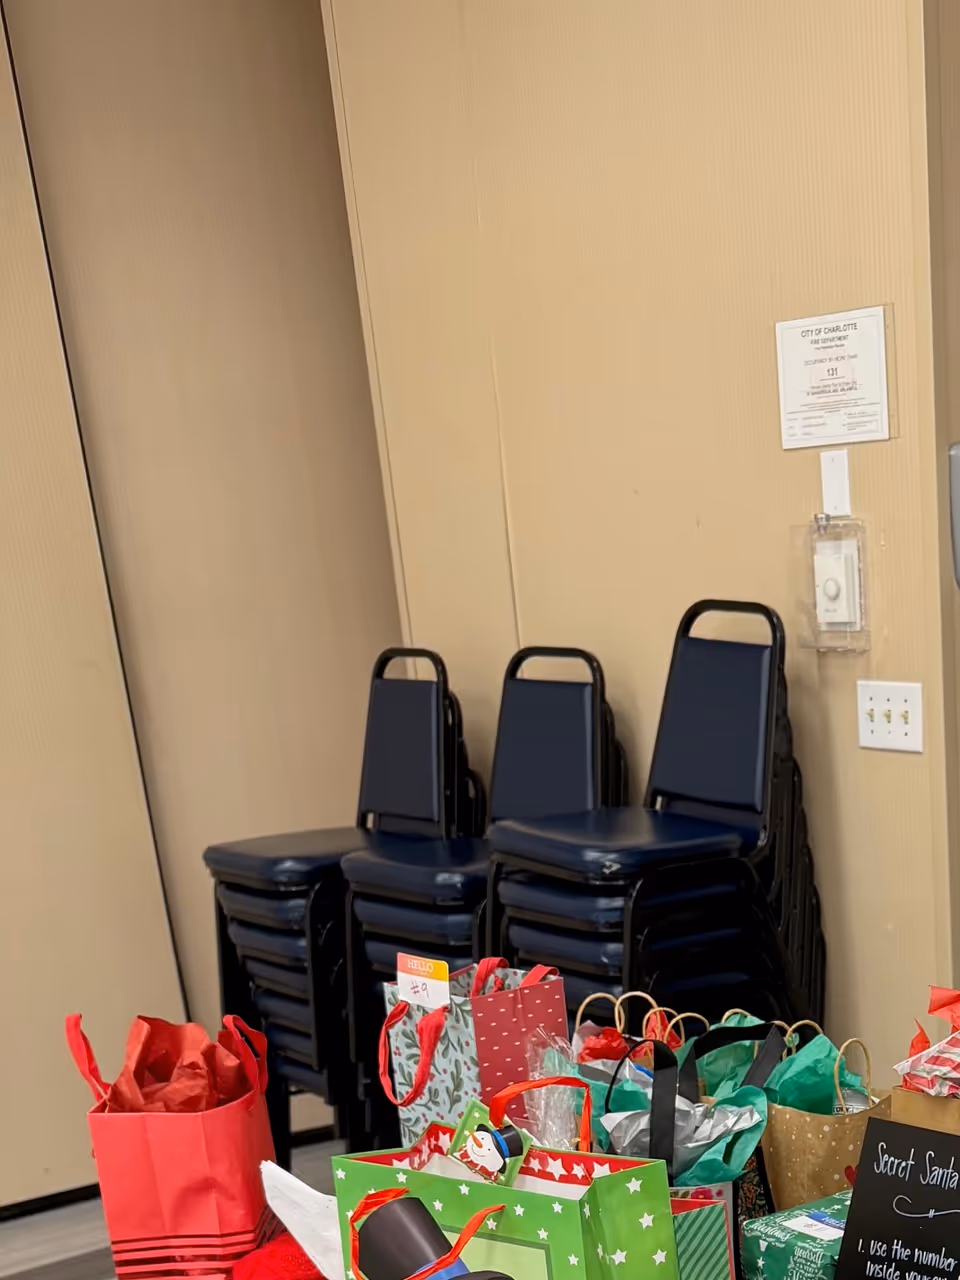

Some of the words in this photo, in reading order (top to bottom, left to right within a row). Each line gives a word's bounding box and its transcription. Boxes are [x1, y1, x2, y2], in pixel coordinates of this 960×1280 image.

[801, 329, 814, 337] CITY
[815, 328, 823, 336] OF
[823, 322, 858, 335] CHARLOTTE
[827, 367, 838, 376] 131
[408, 959, 434, 973] HELLO
[410, 980, 430, 1001] #9
[873, 1142, 915, 1181] Secret
[920, 1151, 960, 1190] Santa
[794, 1246, 825, 1268] yourself
[891, 1239, 912, 1261] the
[914, 1247, 958, 1273] number
